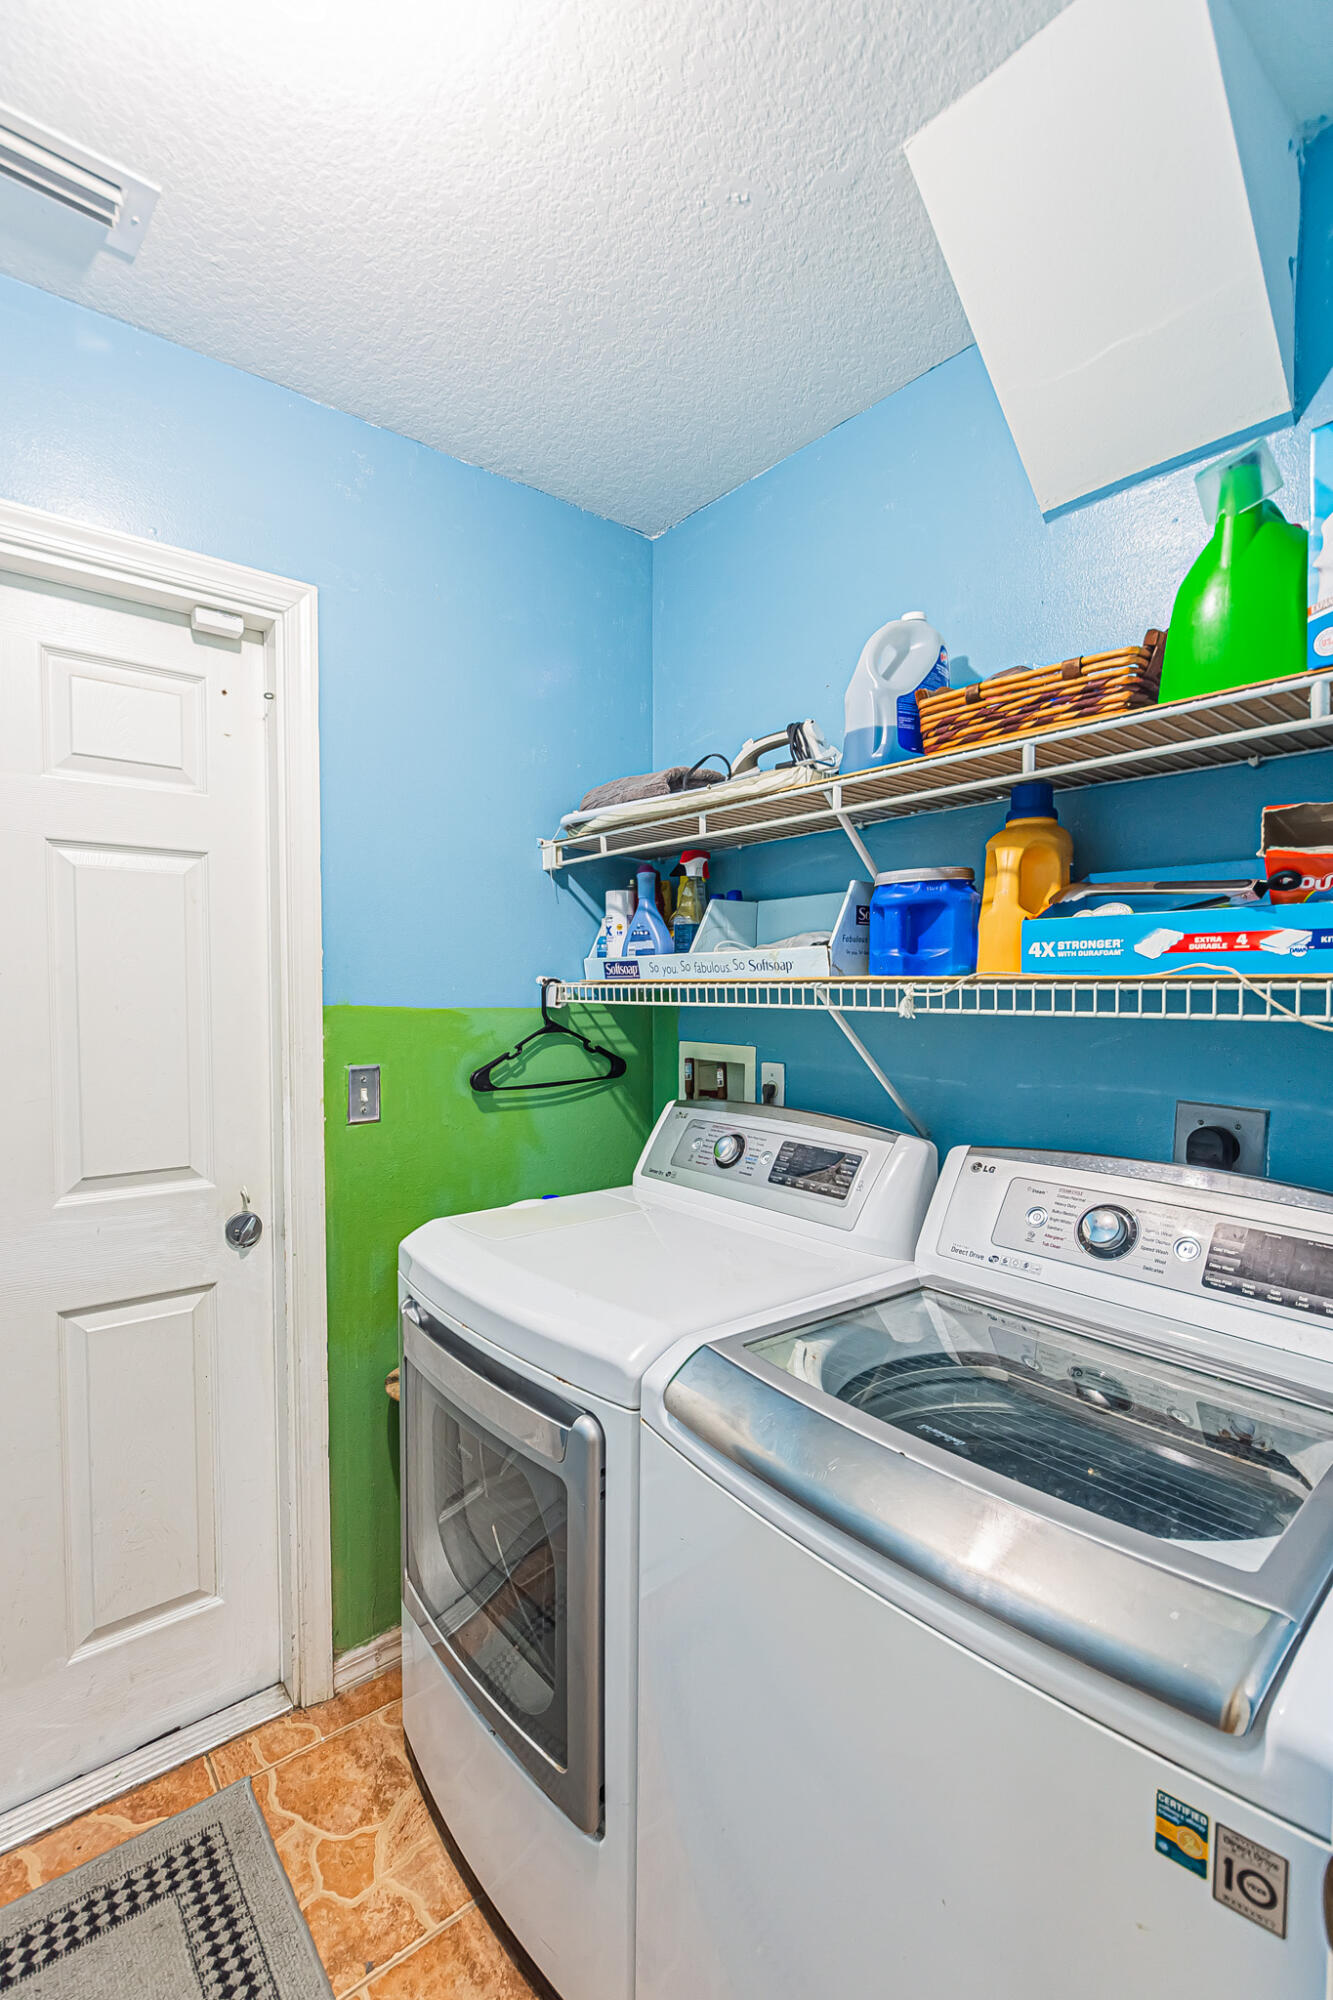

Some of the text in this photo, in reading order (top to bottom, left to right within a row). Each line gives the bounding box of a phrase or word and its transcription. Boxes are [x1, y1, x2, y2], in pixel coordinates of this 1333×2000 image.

[1057, 939, 1121, 950] STRONGER
[1189, 942, 1228, 950] DURABLE
[1194, 935, 1222, 943] EXTRA
[1236, 934, 1248, 945] 4
[1028, 941, 1056, 957] 4X
[605, 962, 638, 976] Softsoap
[648, 959, 794, 977] So you. So fabulous. So Softsoap
[983, 1165, 996, 1174] LG
[951, 1245, 968, 1256] Direct
[969, 1250, 985, 1261] Drive
[1158, 1793, 1208, 1826] CERTIFIED
[1224, 1856, 1278, 1911] 10
